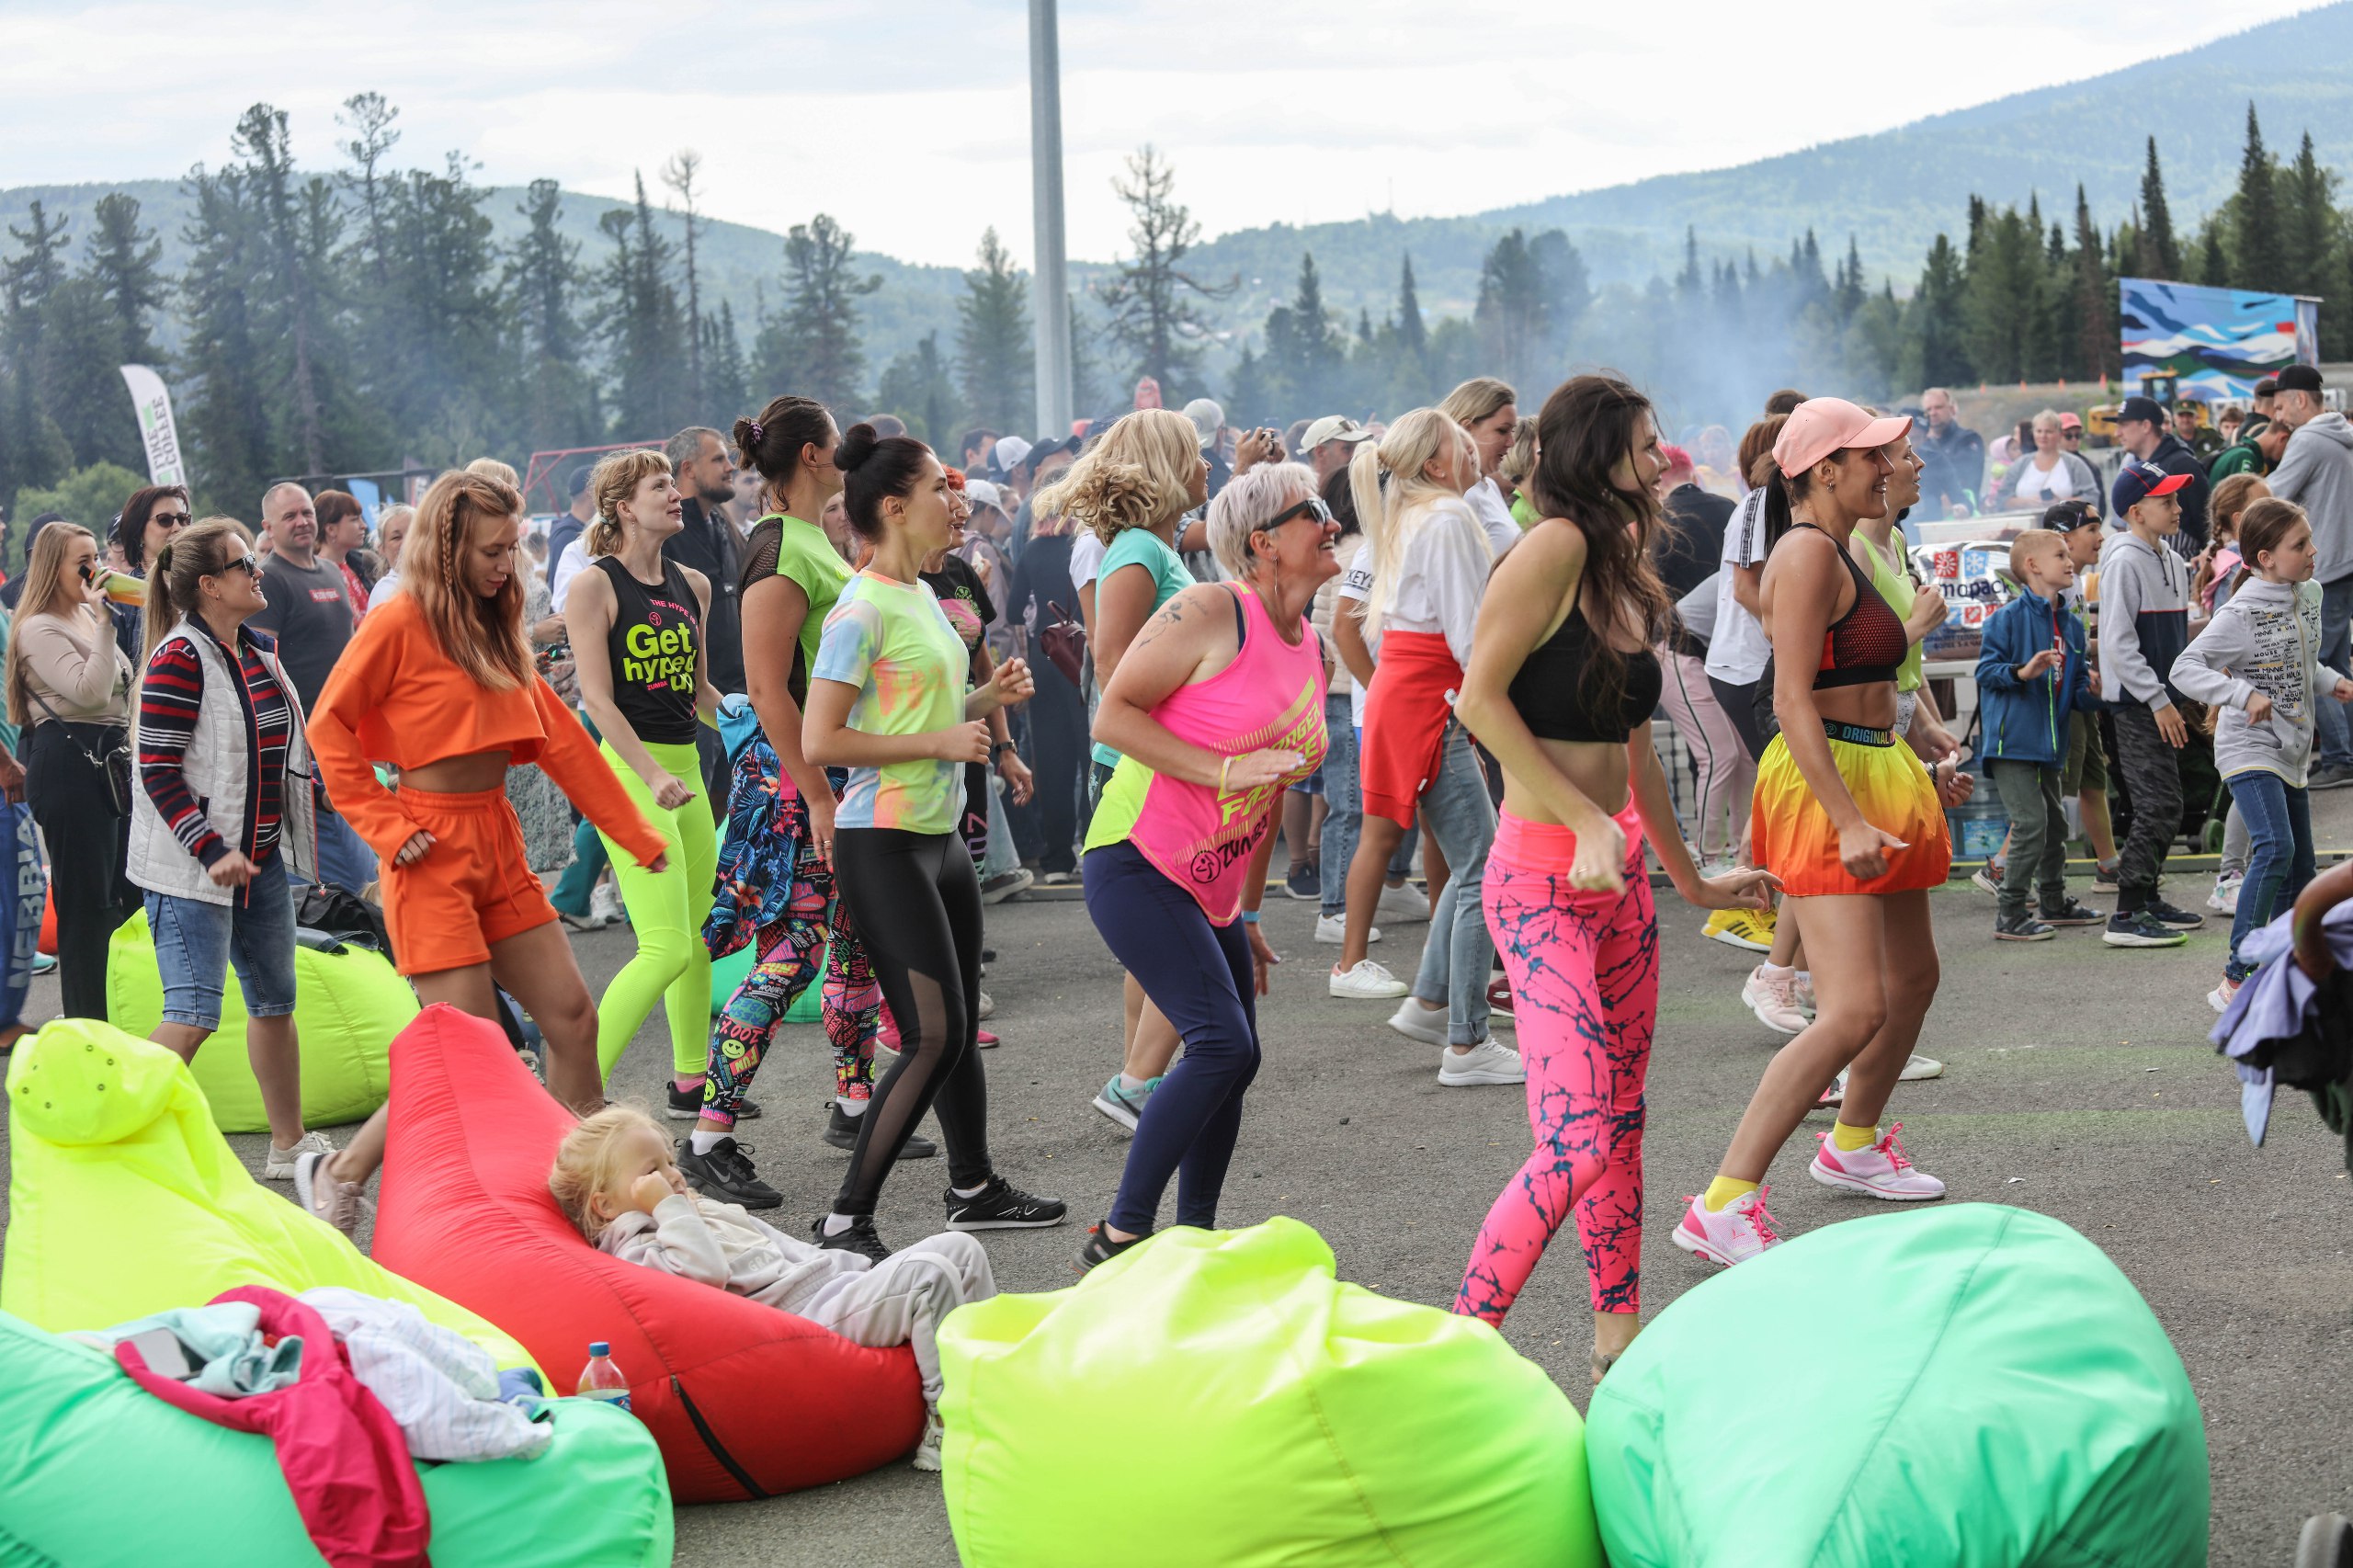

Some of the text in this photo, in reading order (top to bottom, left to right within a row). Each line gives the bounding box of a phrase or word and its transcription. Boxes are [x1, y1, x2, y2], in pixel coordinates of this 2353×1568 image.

[650, 598, 667, 608] THE
[668, 602, 689, 617] HYPE
[626, 622, 692, 659] Get
[623, 649, 698, 684] hyped
[2286, 662, 2302, 670] MOSE
[647, 680, 667, 690] ZUMBA
[670, 672, 693, 694] up
[1842, 725, 1890, 744] ORIGINAL
[7, 812, 46, 989] NEBBIA
[758, 984, 786, 995] HOURS
[767, 973, 791, 986] OPEN
[720, 1020, 765, 1045] 100%
[734, 1045, 759, 1073] FUN
